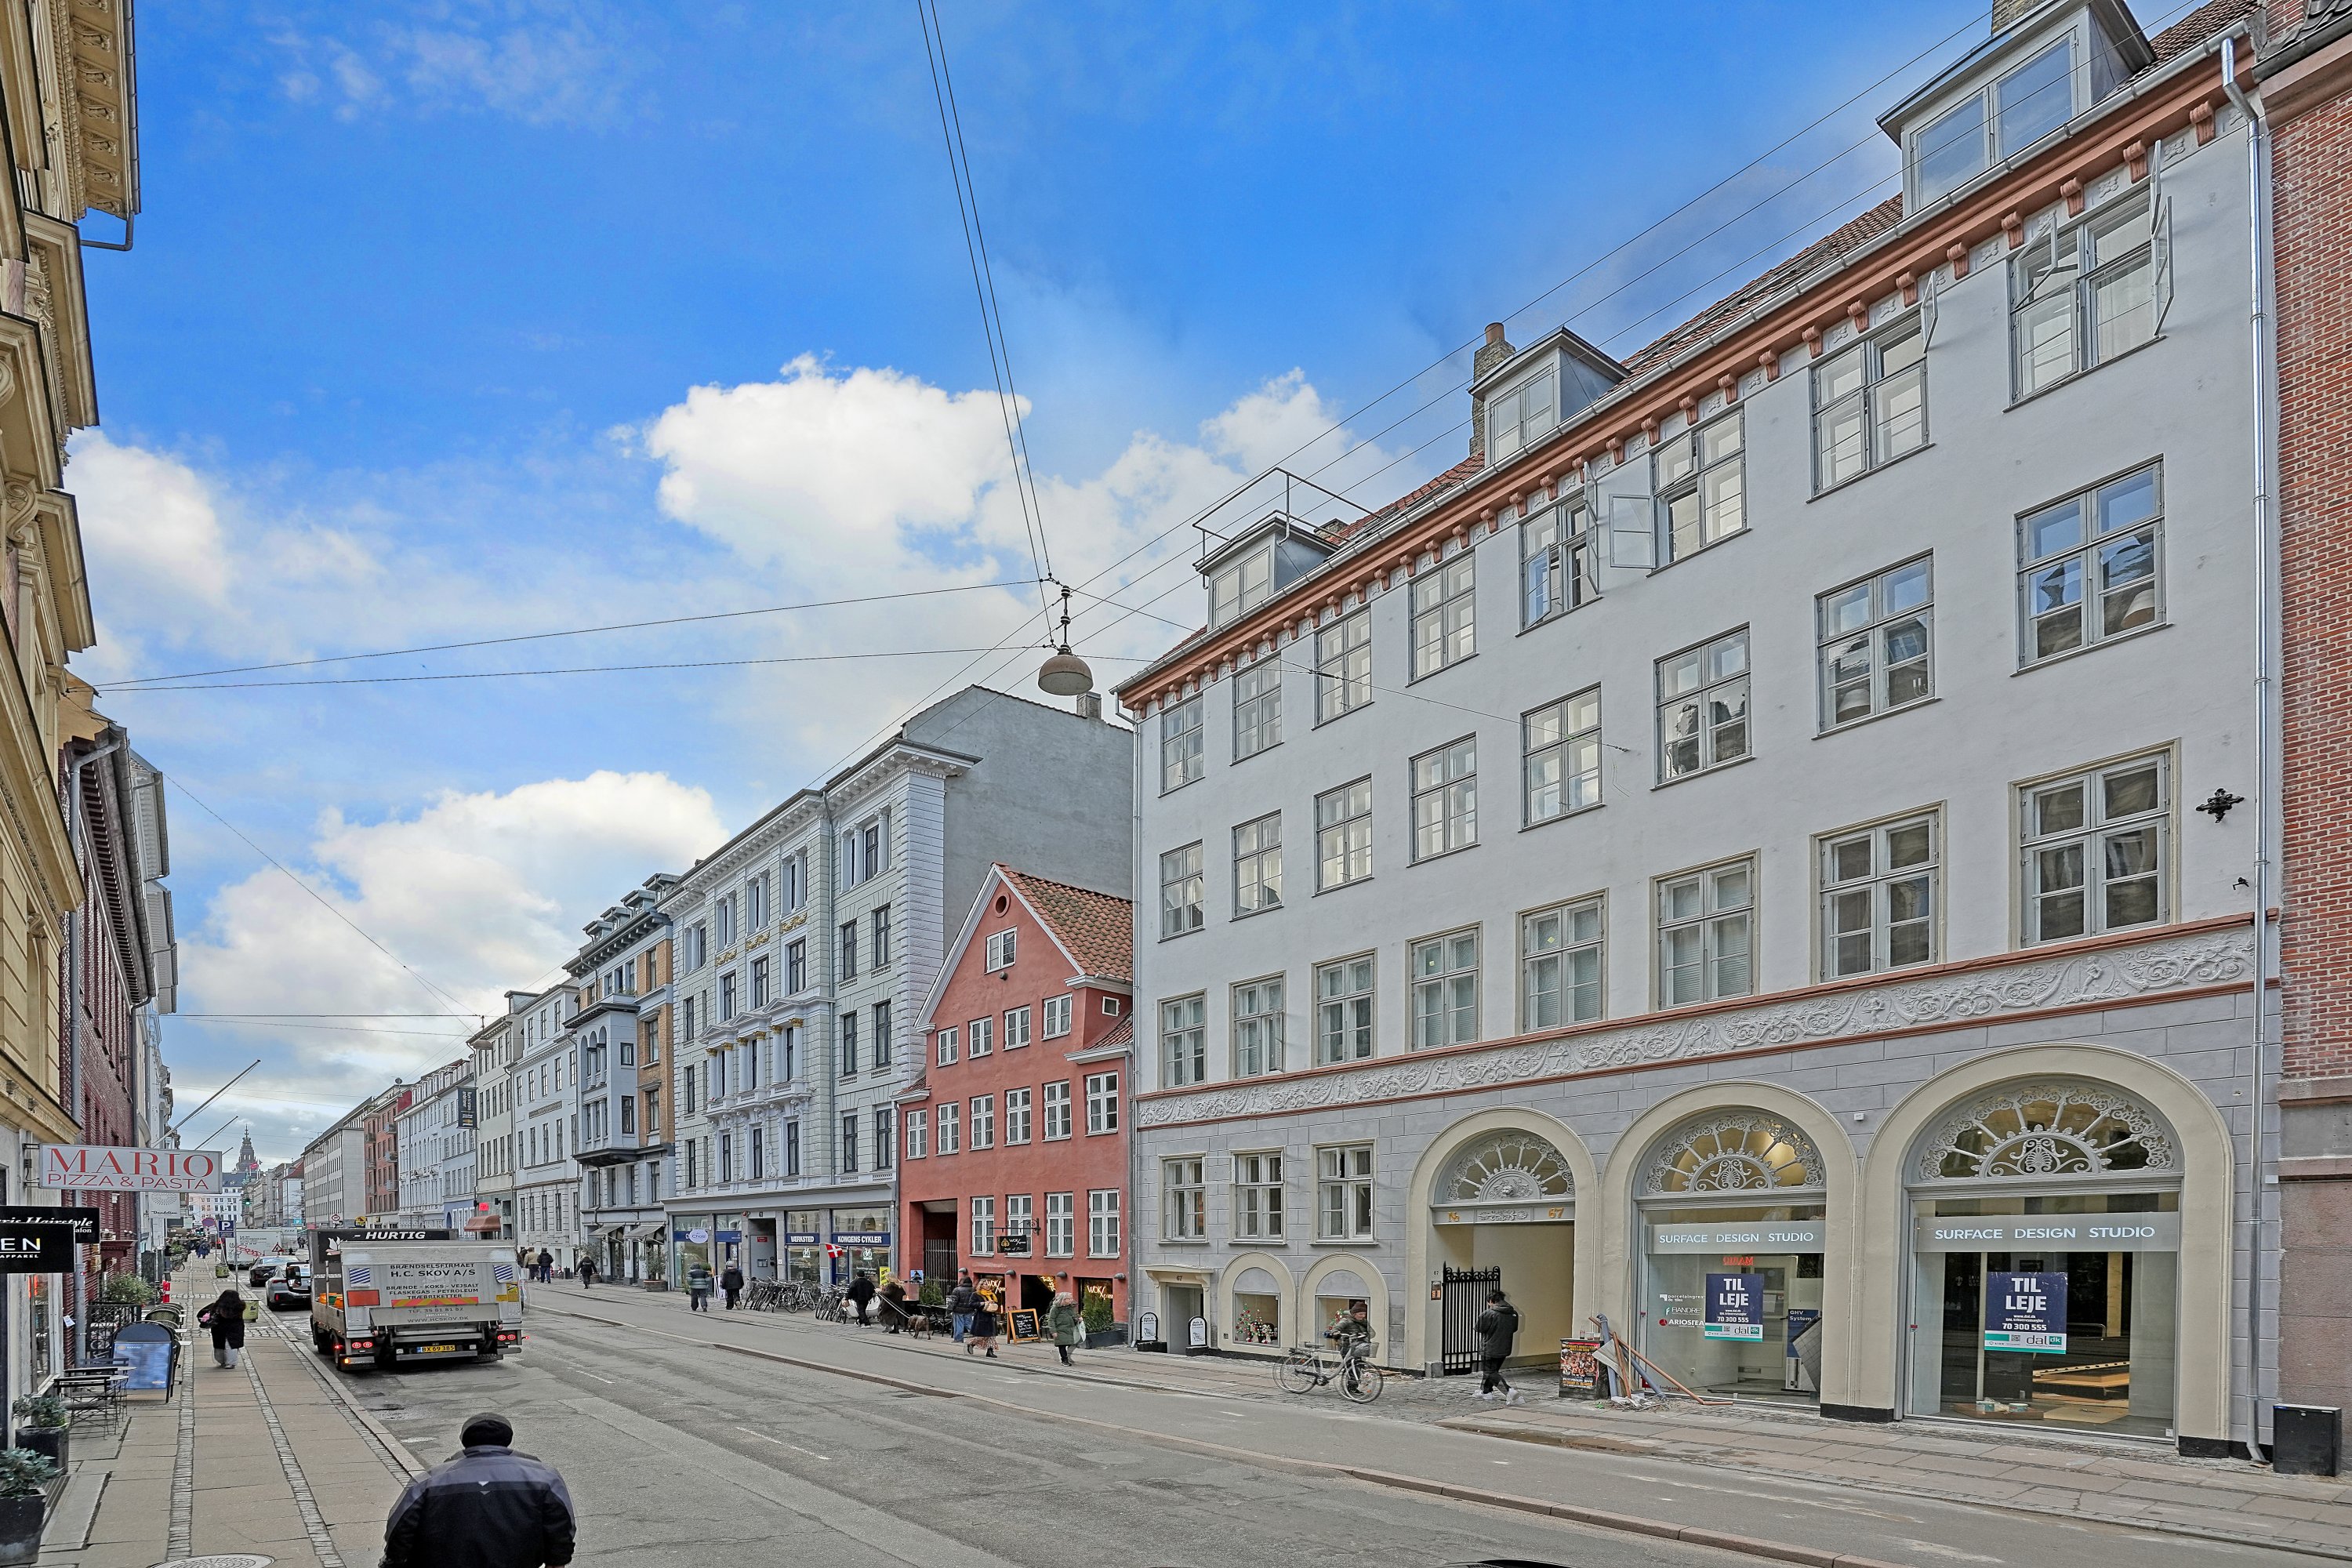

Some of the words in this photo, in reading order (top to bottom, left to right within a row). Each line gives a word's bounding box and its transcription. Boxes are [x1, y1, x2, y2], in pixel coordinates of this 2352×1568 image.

[48, 1148, 214, 1178] MARIO
[48, 1174, 114, 1186] PIZZA
[120, 1176, 133, 1187] &
[141, 1177, 209, 1190] PASTA
[1548, 1207, 1564, 1218] 67
[221, 1221, 231, 1231] P
[1935, 1229, 2002, 1240] SURFACE
[2015, 1228, 2076, 1239] DESIGN
[2089, 1226, 2155, 1238] STUDIO
[1660, 1235, 1708, 1243] SURFACE
[1716, 1233, 1759, 1243] DESIGN
[1769, 1232, 1813, 1242] STUDIO
[1723, 1278, 1745, 1291] TIL
[2011, 1277, 2042, 1293] TIL
[1719, 1293, 1749, 1308] LEJE
[2005, 1295, 2047, 1313] LEJE
[2026, 1335, 2048, 1345] dal
